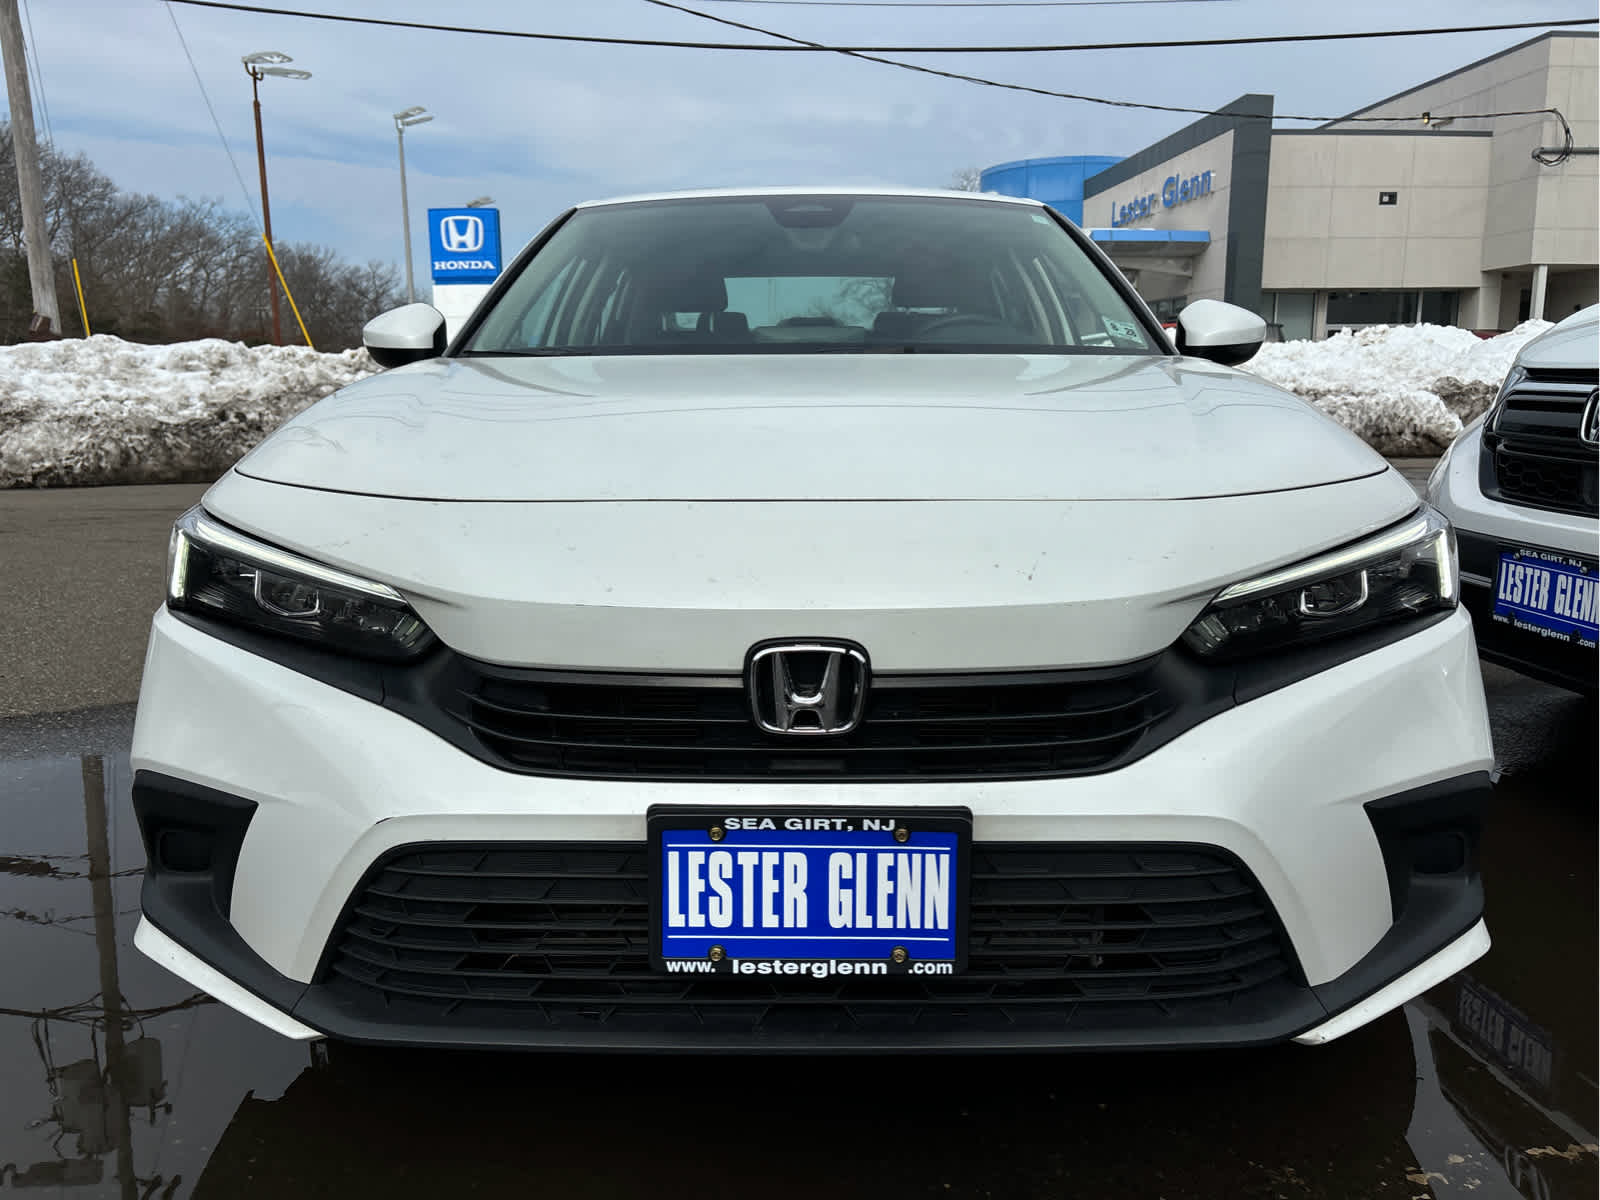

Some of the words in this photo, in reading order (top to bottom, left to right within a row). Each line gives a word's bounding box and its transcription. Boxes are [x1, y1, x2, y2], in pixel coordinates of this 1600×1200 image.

[1111, 193, 1155, 228] Lester
[1162, 169, 1212, 208] Glenn
[433, 260, 496, 270] HONDA
[1519, 549, 1538, 559] SEA
[1568, 558, 1582, 567] NJ
[1498, 561, 1551, 611] LESTER
[1513, 618, 1571, 642] lesterglenn
[724, 818, 777, 830] SEA
[784, 818, 854, 832] GIRT,
[862, 818, 896, 831] NJ
[667, 851, 808, 928] LESTER
[828, 852, 950, 929] GLENN
[665, 961, 717, 973] www.
[732, 959, 888, 978] lesterglenn
[907, 962, 953, 974] .com
